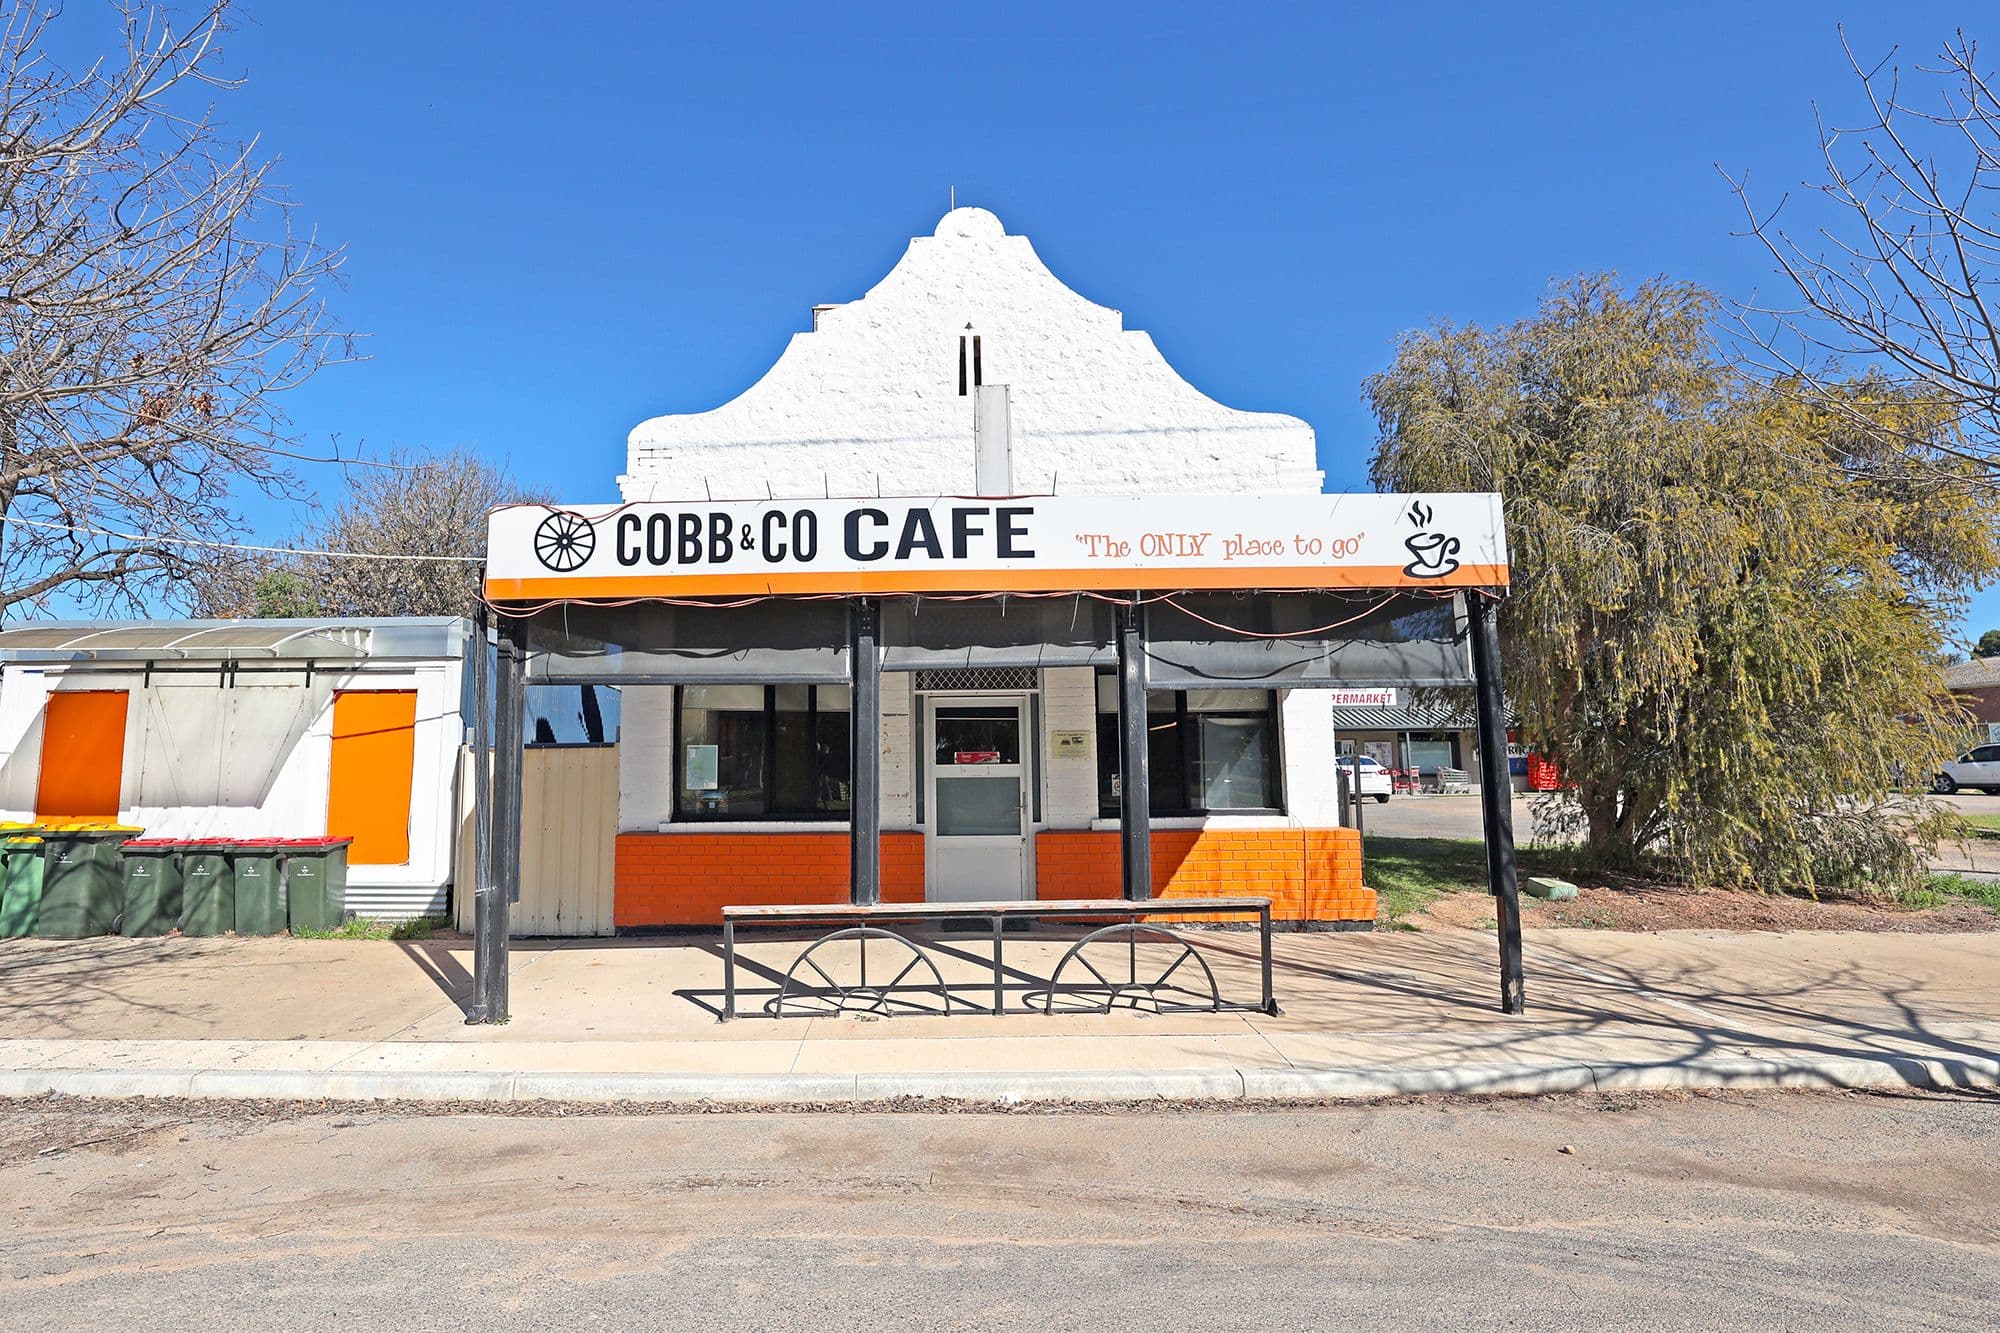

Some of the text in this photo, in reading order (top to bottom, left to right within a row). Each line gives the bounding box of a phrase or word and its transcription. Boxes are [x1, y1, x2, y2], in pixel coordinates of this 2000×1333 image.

[844, 507, 1036, 562] CAFE
[1140, 533, 1212, 557] ONLY
[1222, 533, 1285, 560] place
[1293, 534, 1322, 556] to
